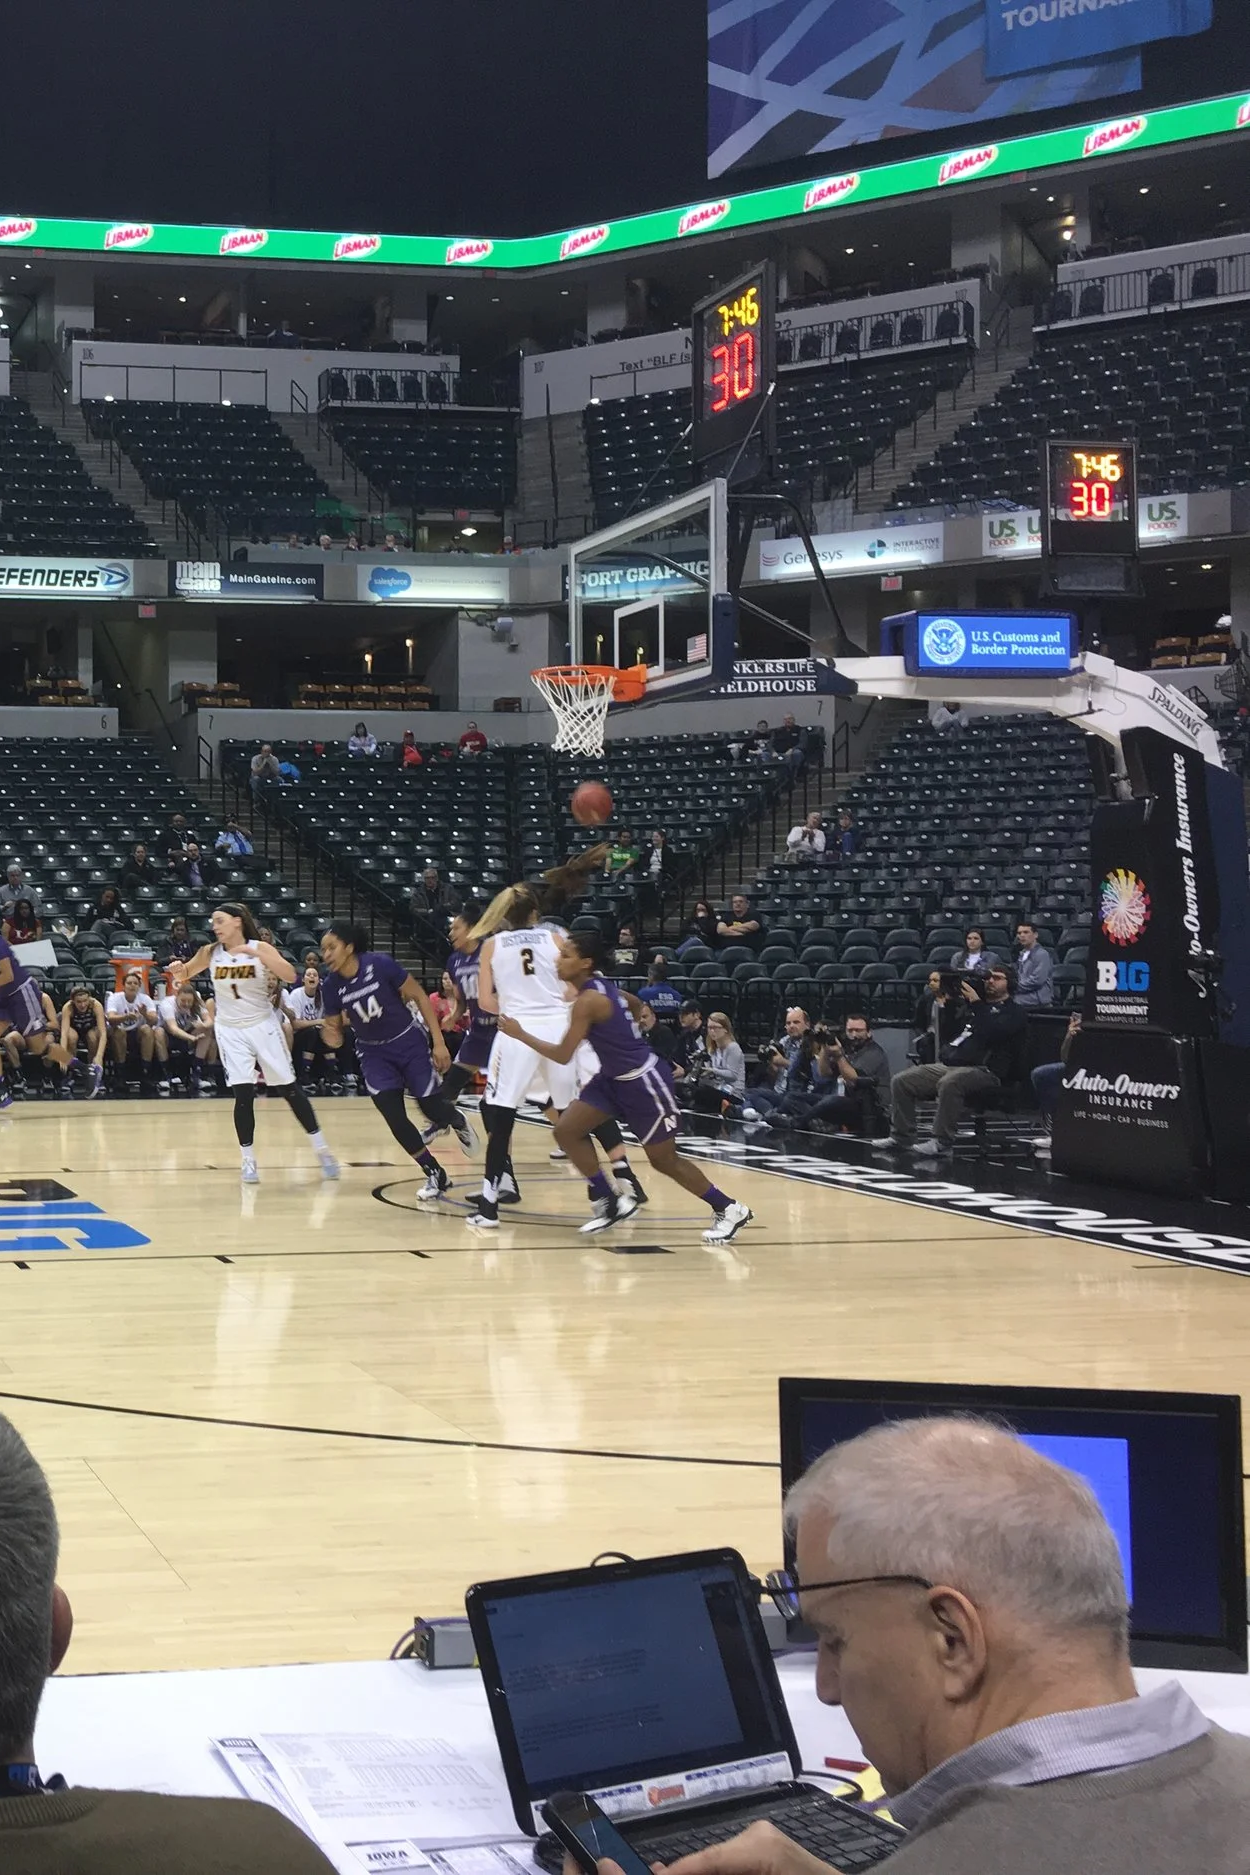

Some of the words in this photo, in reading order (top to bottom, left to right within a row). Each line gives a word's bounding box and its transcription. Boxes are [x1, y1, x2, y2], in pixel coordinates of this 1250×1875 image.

[1084, 120, 1142, 155] LIBMAN
[939, 148, 994, 183] LIBMAN
[804, 176, 856, 209] LIBMAN
[679, 203, 727, 235] LIBMAN
[105, 227, 150, 248] LIBMAN
[220, 232, 264, 253] LIBMAN
[334, 238, 378, 258] LIBMAN
[561, 228, 606, 258] LIBMAN
[446, 243, 490, 264] LIBMAN
[718, 287, 758, 336] 7:46
[619, 360, 644, 372] Text
[712, 332, 754, 412] 30
[1073, 453, 1122, 481] 7:46
[1071, 481, 1111, 517] 30
[229, 573, 317, 586] MainGateInc.com
[373, 577, 409, 587] salesforce
[971, 631, 990, 642] U.S.
[992, 631, 1039, 643] Customs
[1040, 631, 1061, 643] and
[971, 644, 1008, 655] Border
[1010, 644, 1066, 655] Protection
[733, 662, 786, 674] NKERS
[1148, 687, 1203, 737] SPALDING
[1172, 752, 1194, 854] Insurance
[1181, 855, 1208, 999] Ato-Owners
[214, 965, 257, 980] IOWA
[520, 948, 536, 976] 2
[230, 983, 241, 1000] 1
[351, 994, 384, 1024] 14
[1095, 1003, 1149, 1016] TOURNAMENT
[1061, 1067, 1181, 1100] Auto-Owners
[1088, 1093, 1154, 1111] INSURANCE
[1137, 1117, 1169, 1129] BUSINESS
